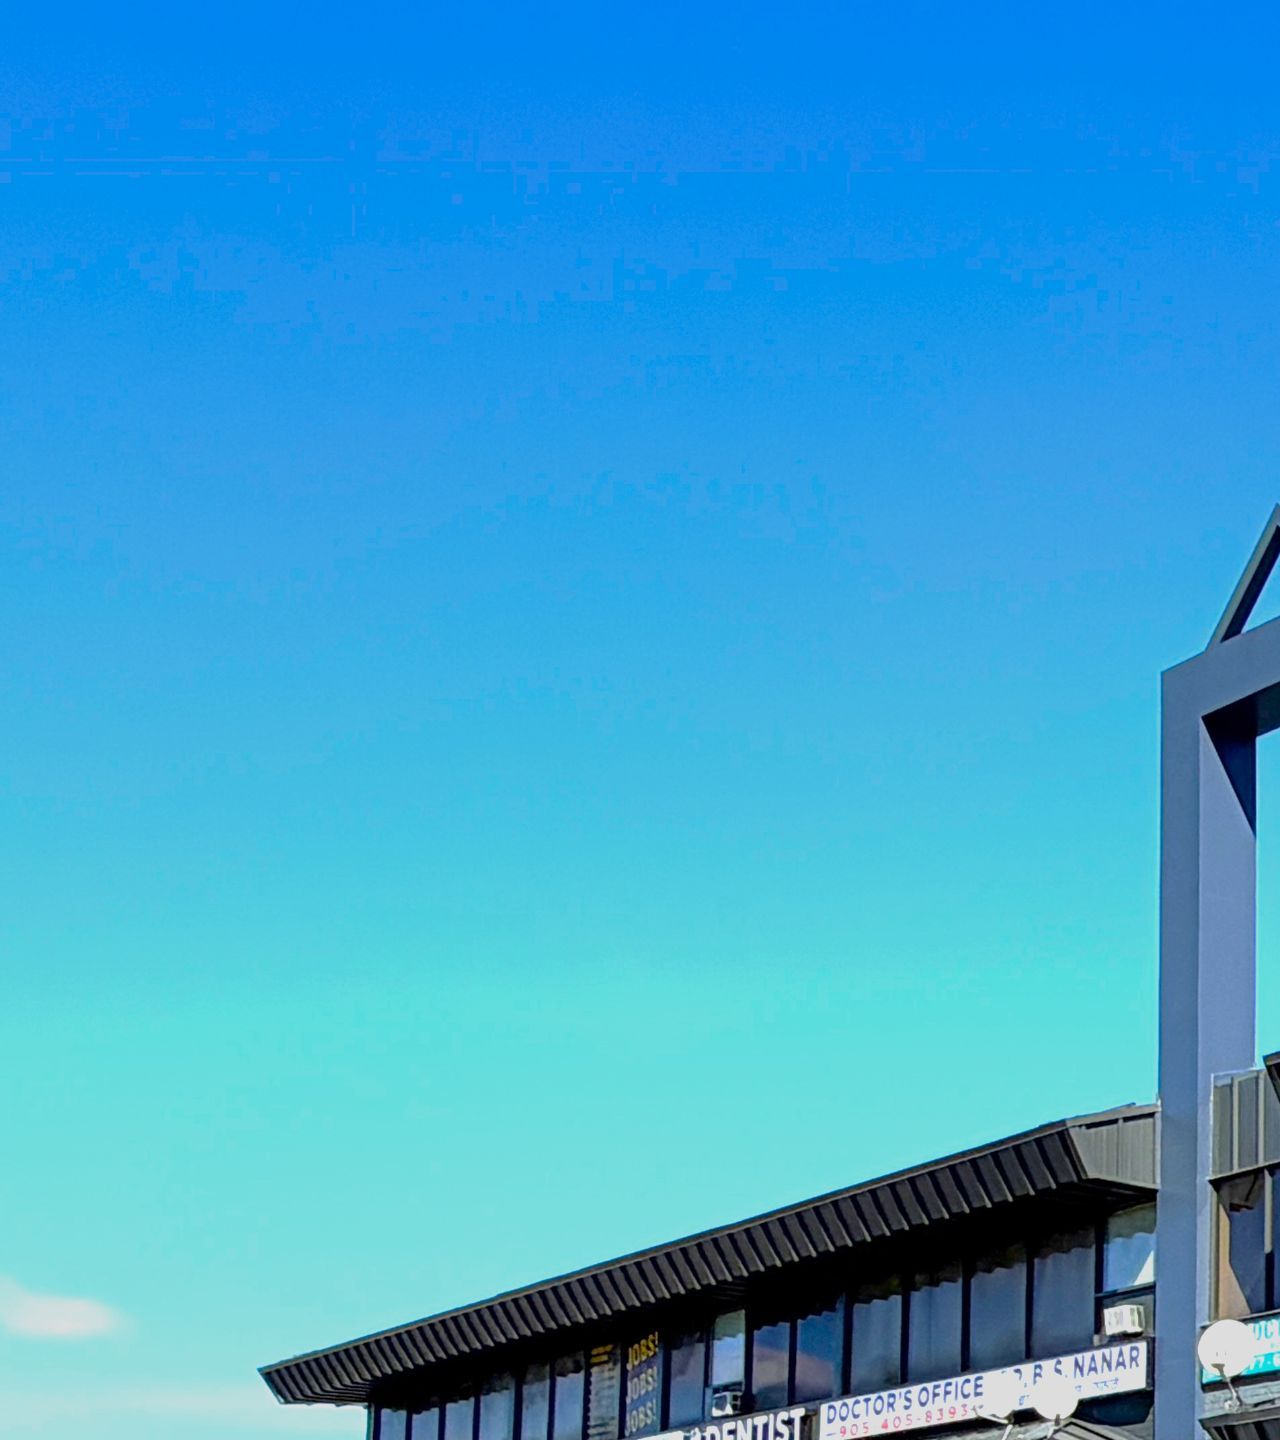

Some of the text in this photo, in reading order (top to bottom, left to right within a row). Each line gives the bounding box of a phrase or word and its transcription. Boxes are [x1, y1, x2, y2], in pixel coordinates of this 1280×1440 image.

[626, 1331, 658, 1371] JOBS!
[626, 1366, 657, 1404] JOBS!
[826, 1388, 913, 1425] DOCTOR'S
[917, 1375, 984, 1408] OFFICE
[1073, 1345, 1141, 1379] NANAR
[624, 1397, 656, 1437] JOBS!
[839, 1421, 869, 1438] 905
